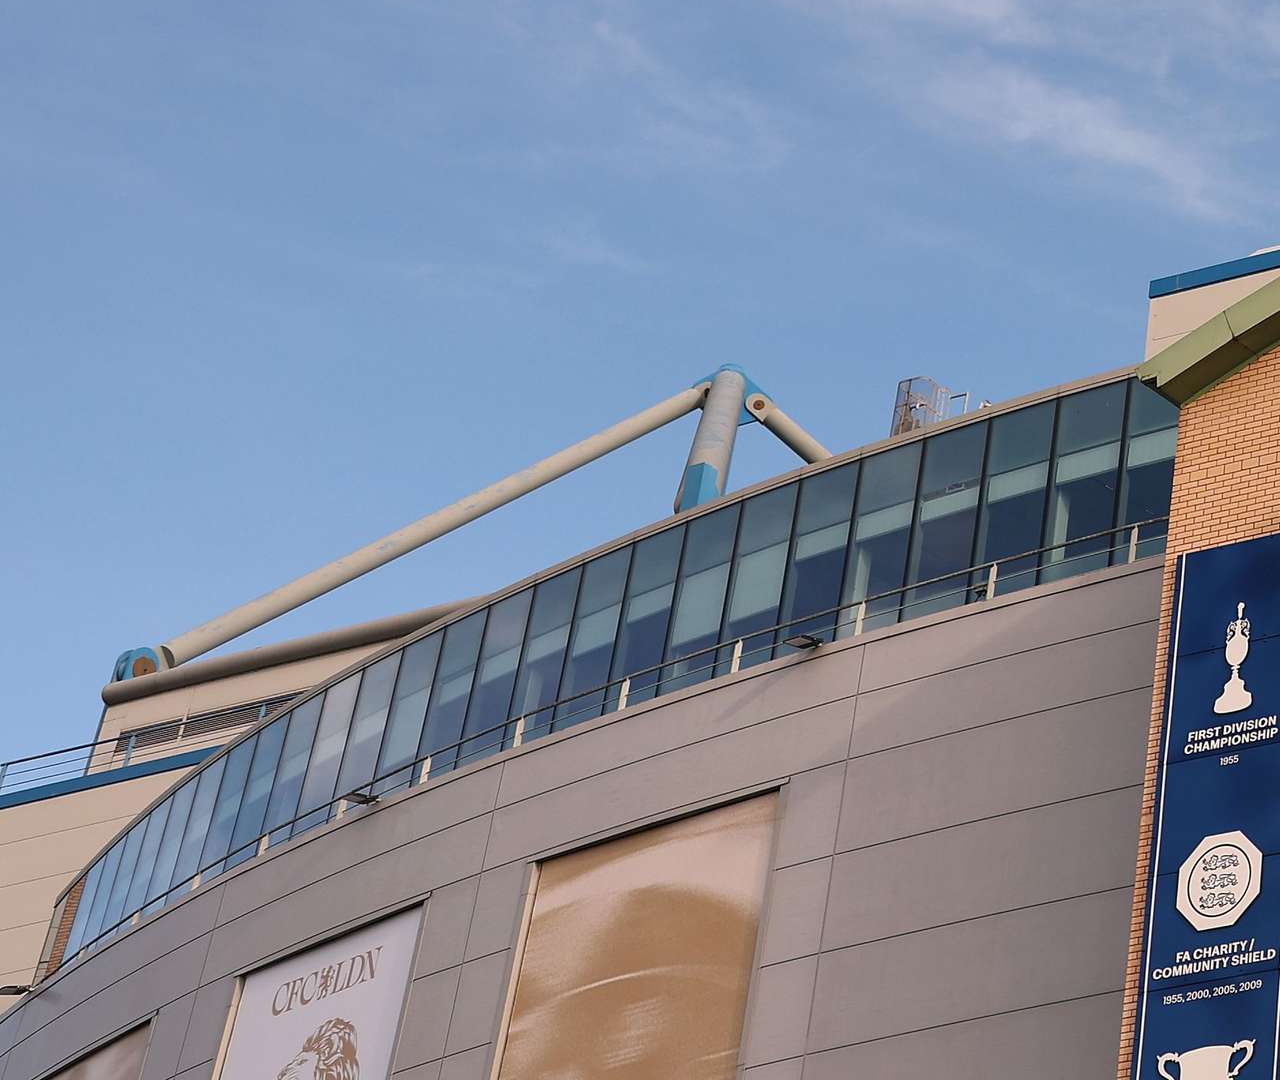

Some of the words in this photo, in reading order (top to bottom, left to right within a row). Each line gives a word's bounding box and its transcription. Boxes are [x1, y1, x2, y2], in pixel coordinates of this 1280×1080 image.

[1184, 727, 1279, 755] CHAMPIONSHIP
[1187, 726, 1221, 742] FIRST
[1223, 715, 1277, 735] DIVISION
[1220, 754, 1240, 766] 1955
[1152, 956, 1230, 980] COMMUNITY
[1231, 948, 1277, 966] SHIELD
[1176, 951, 1191, 963] FA
[1193, 940, 1248, 960] CHARITY
[1248, 938, 1255, 951] /
[272, 971, 320, 1016] CFC
[330, 945, 383, 995] LDN
[1163, 994, 1185, 1005] 1955,
[1186, 989, 1212, 1001] 2000,
[1213, 984, 1238, 996] 2005,
[1239, 979, 1263, 992] 2009
